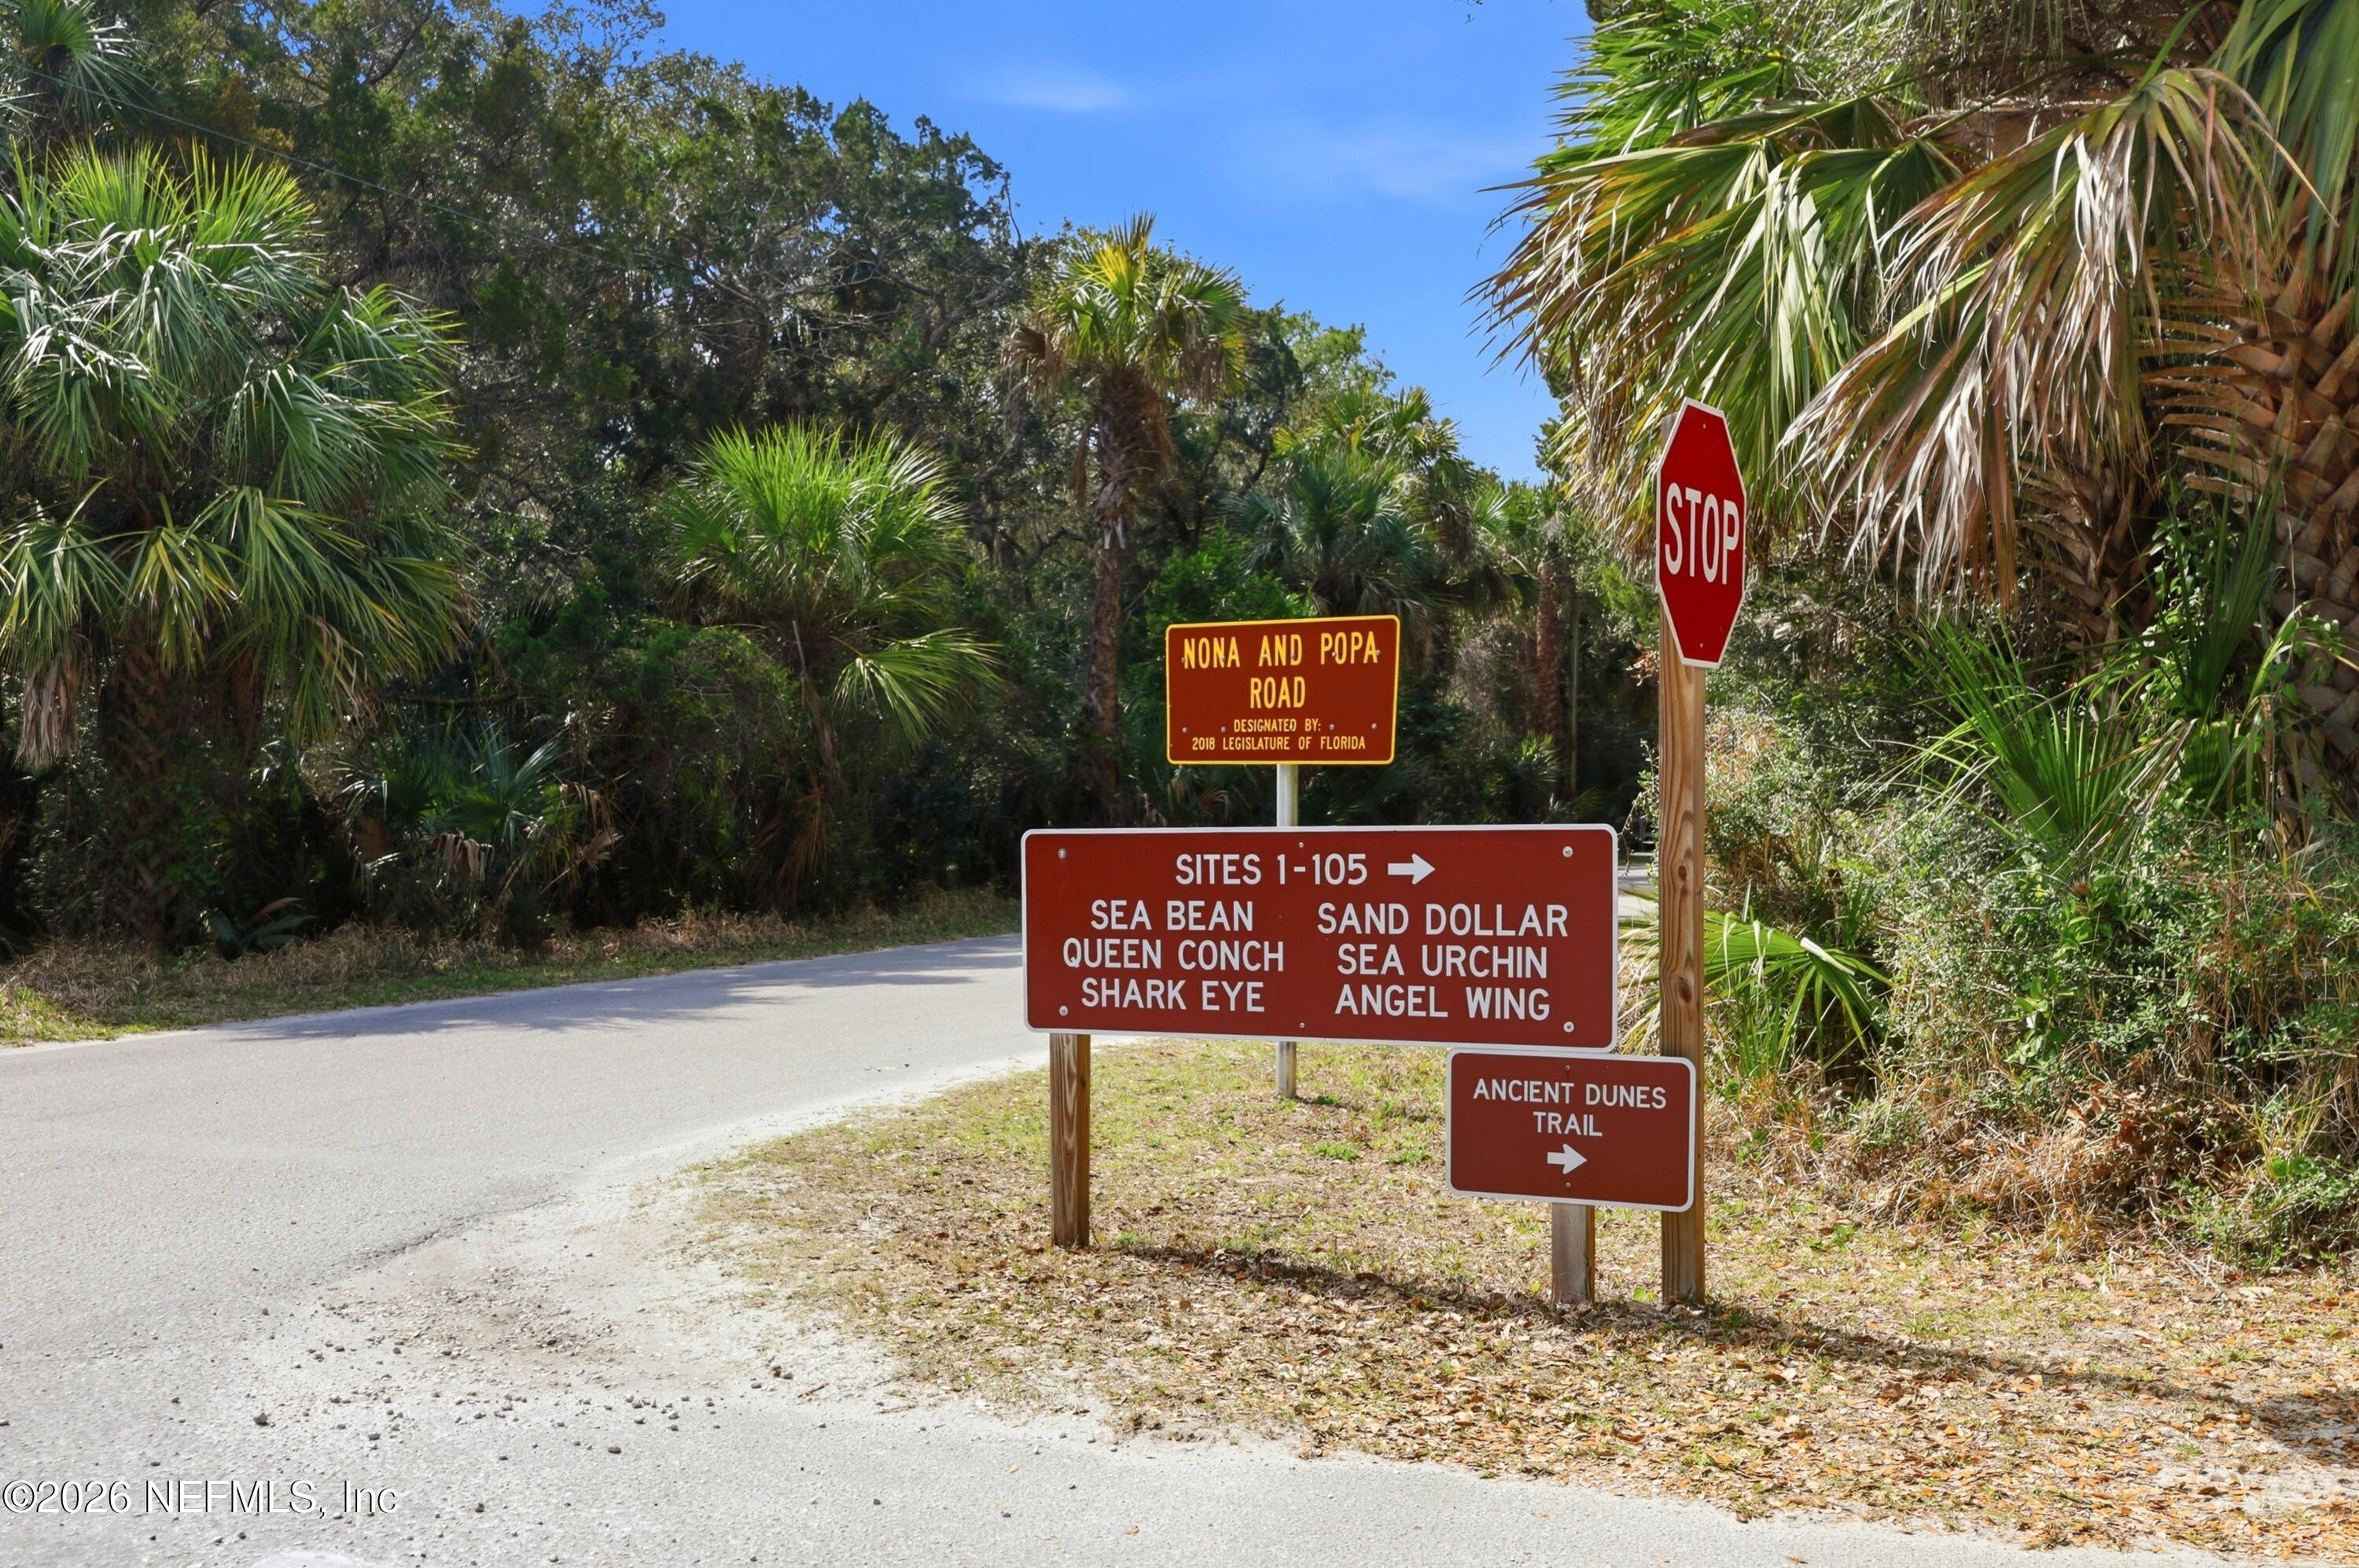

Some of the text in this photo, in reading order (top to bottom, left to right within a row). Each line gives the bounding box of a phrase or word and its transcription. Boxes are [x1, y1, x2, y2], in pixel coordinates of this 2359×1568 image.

[1665, 482, 1740, 585] STOP
[1183, 631, 1378, 669] NONA AND POPA
[1249, 676, 1306, 709] ROAD
[1192, 735, 1366, 750] 2018 LEGISLATURE OF FLORIDA
[1234, 718, 1322, 733] DESIGNATED BY:
[1175, 853, 1368, 885] SITES 1-105
[1091, 899, 1253, 932] SEA BEAN
[1317, 902, 1568, 937] SAND DOLLAR
[1062, 937, 1284, 972] QUEEN CONCH
[1338, 943, 1548, 979] SEA URCHIN
[1081, 977, 1265, 1012] SHARK EYE
[1334, 983, 1550, 1021] ANGEL WING
[1473, 1078, 1666, 1110] ANCIENT DUNES
[1533, 1111, 1603, 1137] TRAIL
